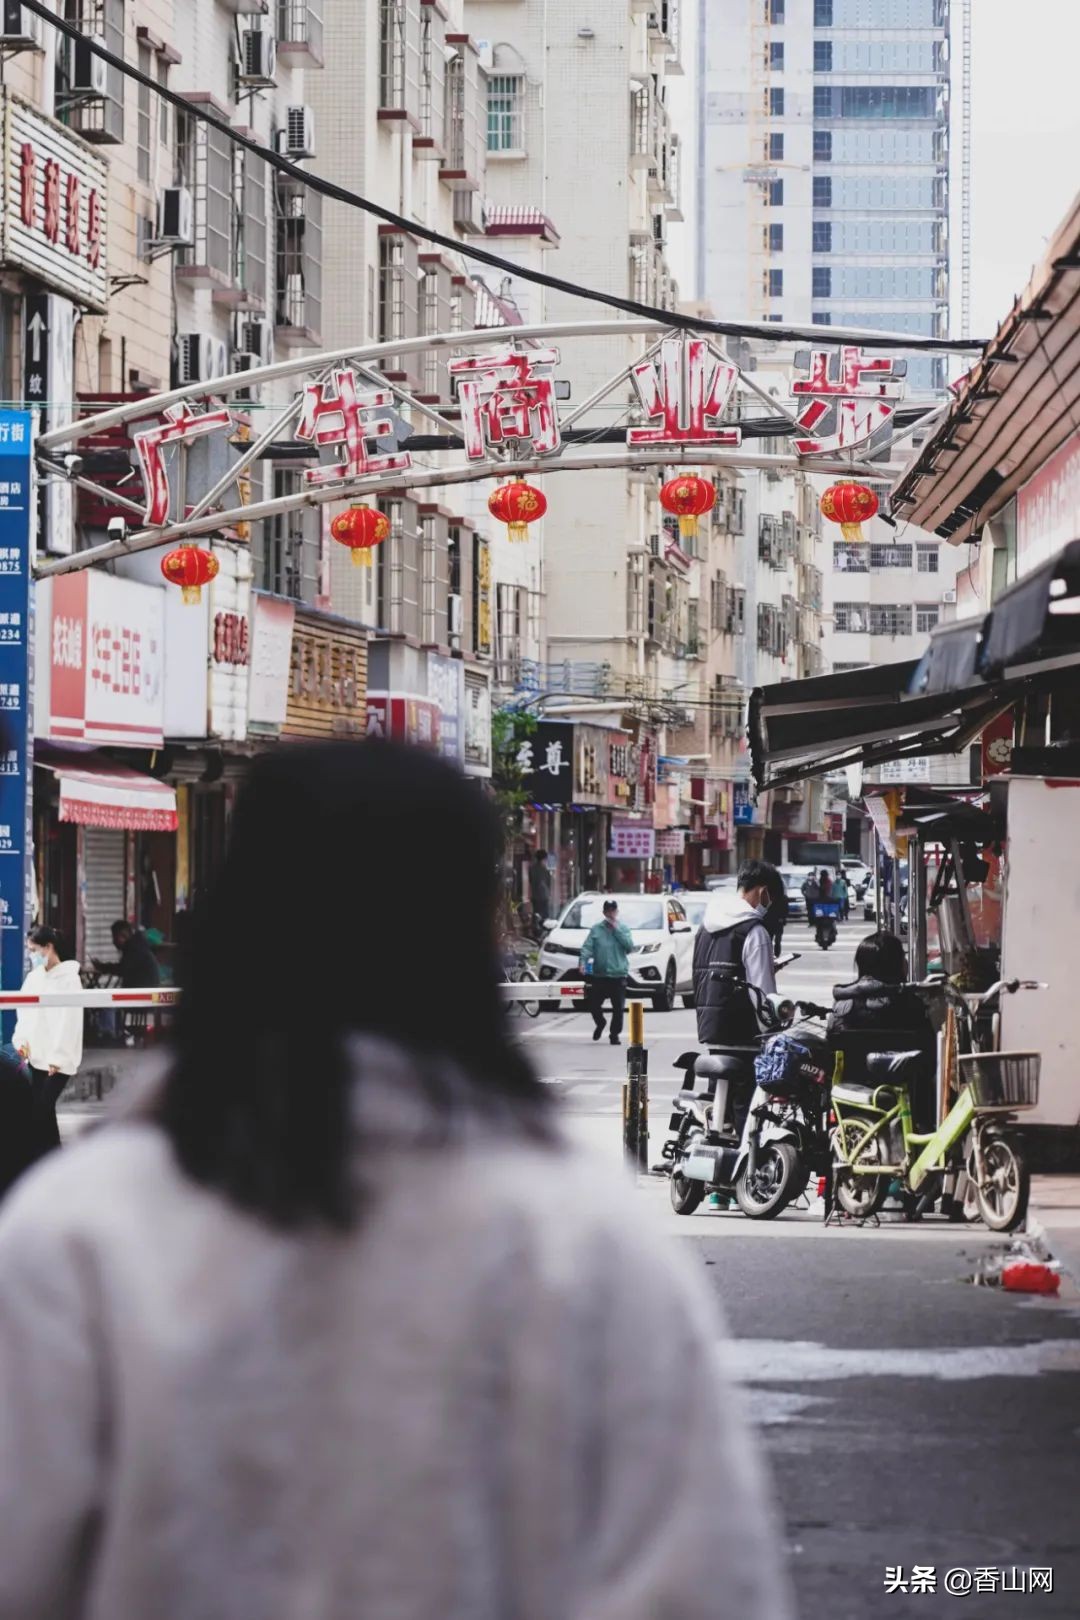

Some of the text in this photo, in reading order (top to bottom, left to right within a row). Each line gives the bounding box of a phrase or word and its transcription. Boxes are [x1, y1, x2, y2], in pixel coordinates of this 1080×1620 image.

[0, 562, 20, 572] 875
[0, 629, 20, 640] 234
[516, 740, 570, 776] 至尊
